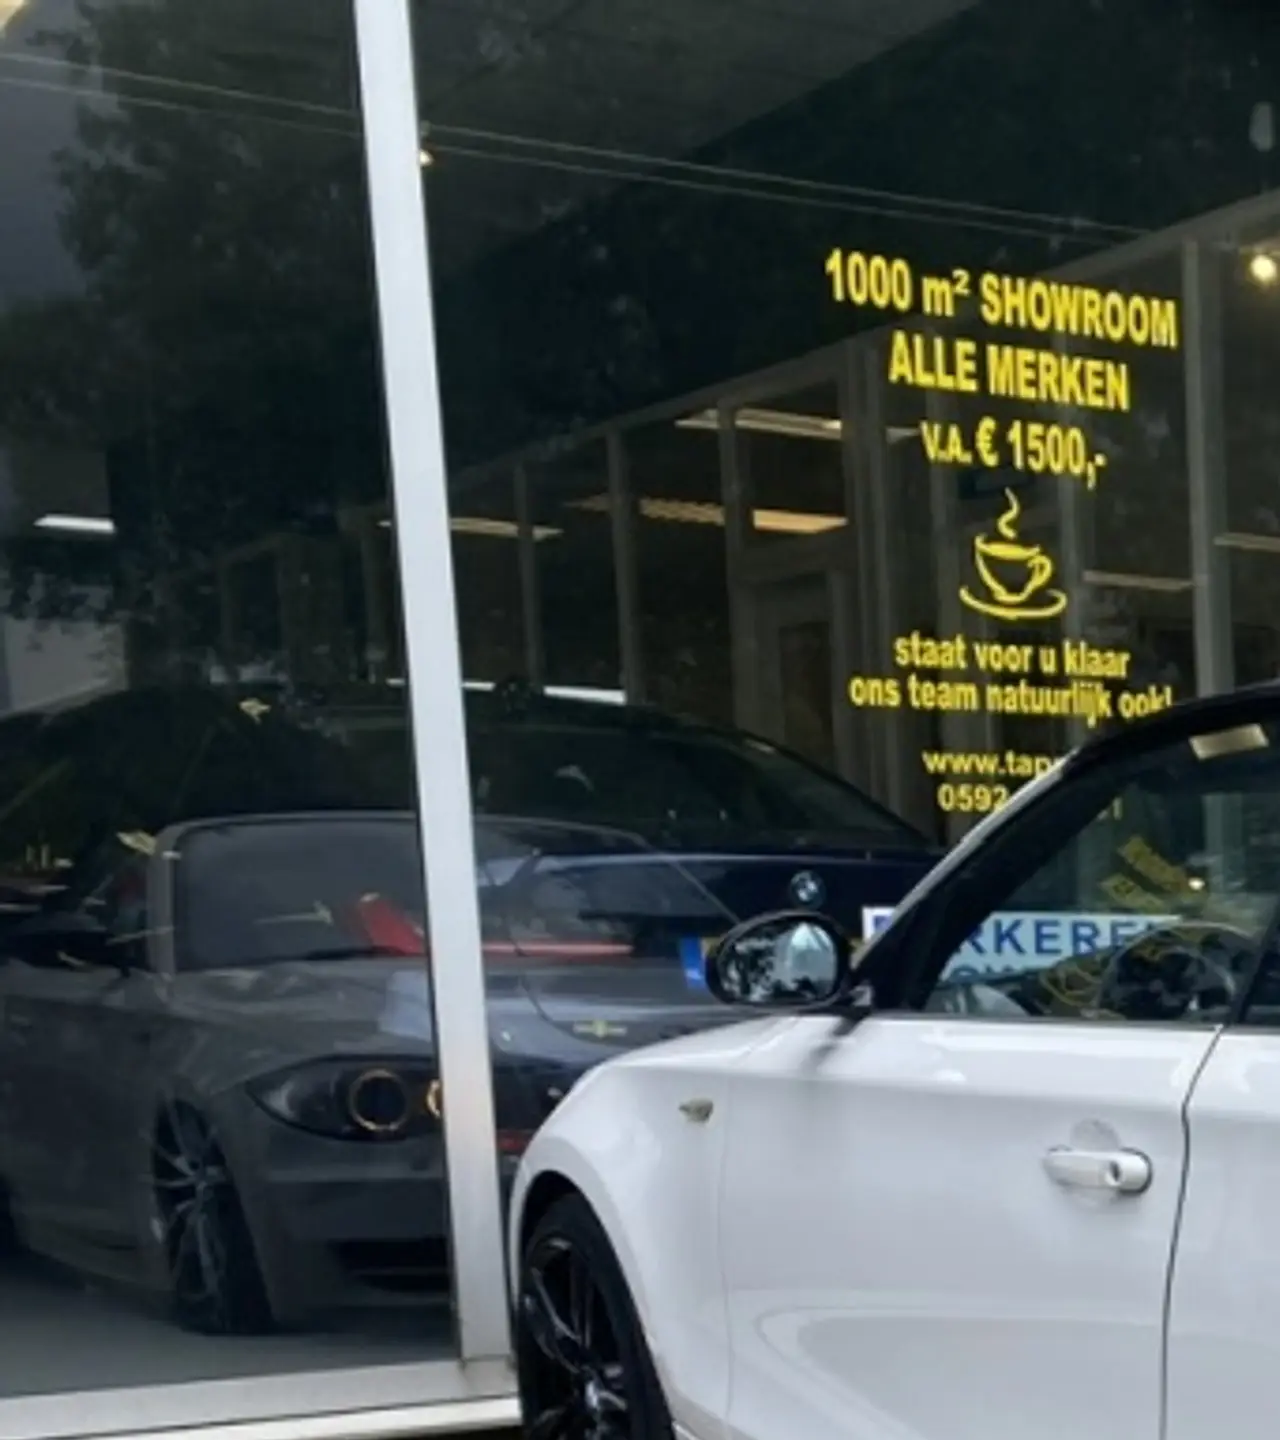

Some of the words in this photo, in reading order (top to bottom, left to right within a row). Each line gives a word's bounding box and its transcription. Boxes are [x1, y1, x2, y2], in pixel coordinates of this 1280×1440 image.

[825, 248, 913, 312] 1000
[922, 269, 970, 317] m²
[979, 271, 1179, 349] SHOWROOM
[888, 329, 978, 394] ALLE
[986, 344, 1131, 412] MERKEN
[920, 420, 973, 464] V.A.
[975, 415, 999, 468] €
[1007, 420, 1107, 490] 1500,-
[893, 631, 967, 671] staat
[973, 642, 1032, 674] voor
[1039, 646, 1056, 675] u
[1062, 641, 1131, 678] klaar
[849, 674, 900, 709] ons
[907, 673, 979, 712] team
[985, 680, 1113, 728] natuurlijk
[921, 749, 1058, 778] www.tap
